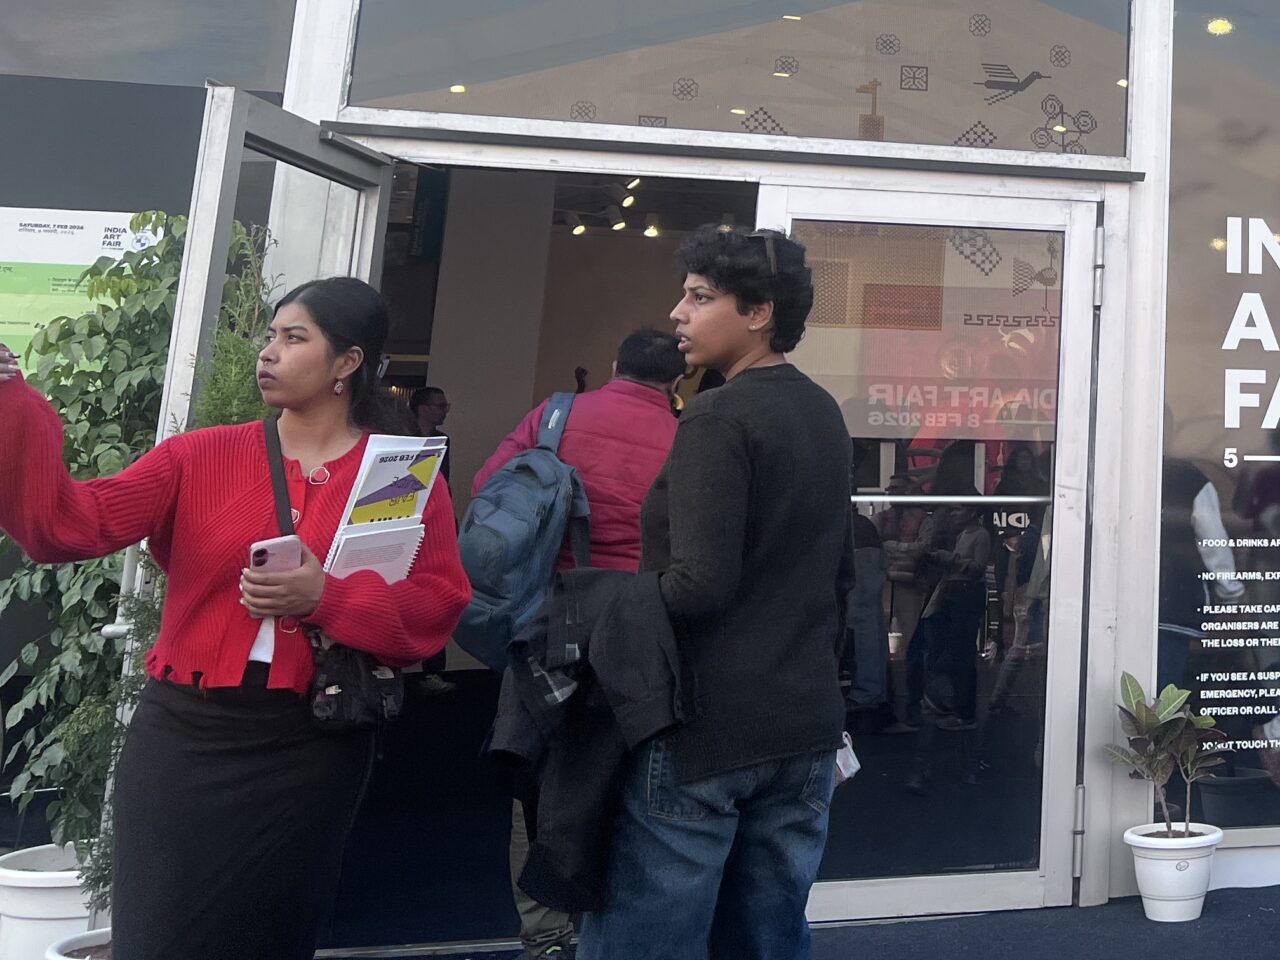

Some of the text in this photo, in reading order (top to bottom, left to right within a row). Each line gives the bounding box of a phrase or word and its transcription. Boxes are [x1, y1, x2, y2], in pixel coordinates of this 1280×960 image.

[1224, 448, 1238, 468] 5
[1202, 539, 1227, 547] FOOD
[1228, 539, 1235, 547] &
[1236, 539, 1269, 547] DRINKS
[1202, 572, 1215, 580] NO
[1216, 572, 1264, 581] FIREARMS,
[1203, 605, 1238, 613] PLEASE
[1239, 605, 1262, 613] TAKE
[1201, 621, 1259, 630] ORGANISERS
[1260, 621, 1279, 629] ARE
[1201, 639, 1220, 647] THE
[1221, 639, 1244, 647] LOSS
[1246, 638, 1259, 647] OR
[1200, 673, 1209, 681] IF
[1210, 673, 1229, 681] YOU
[1231, 672, 1248, 681] SEE
[1249, 672, 1256, 680] A
[1200, 689, 1258, 699] EMERGENCY,
[1200, 707, 1238, 715] OFFICER
[1240, 706, 1253, 715] OR
[1254, 706, 1278, 714] CALL
[1236, 740, 1267, 749] TOUCH
